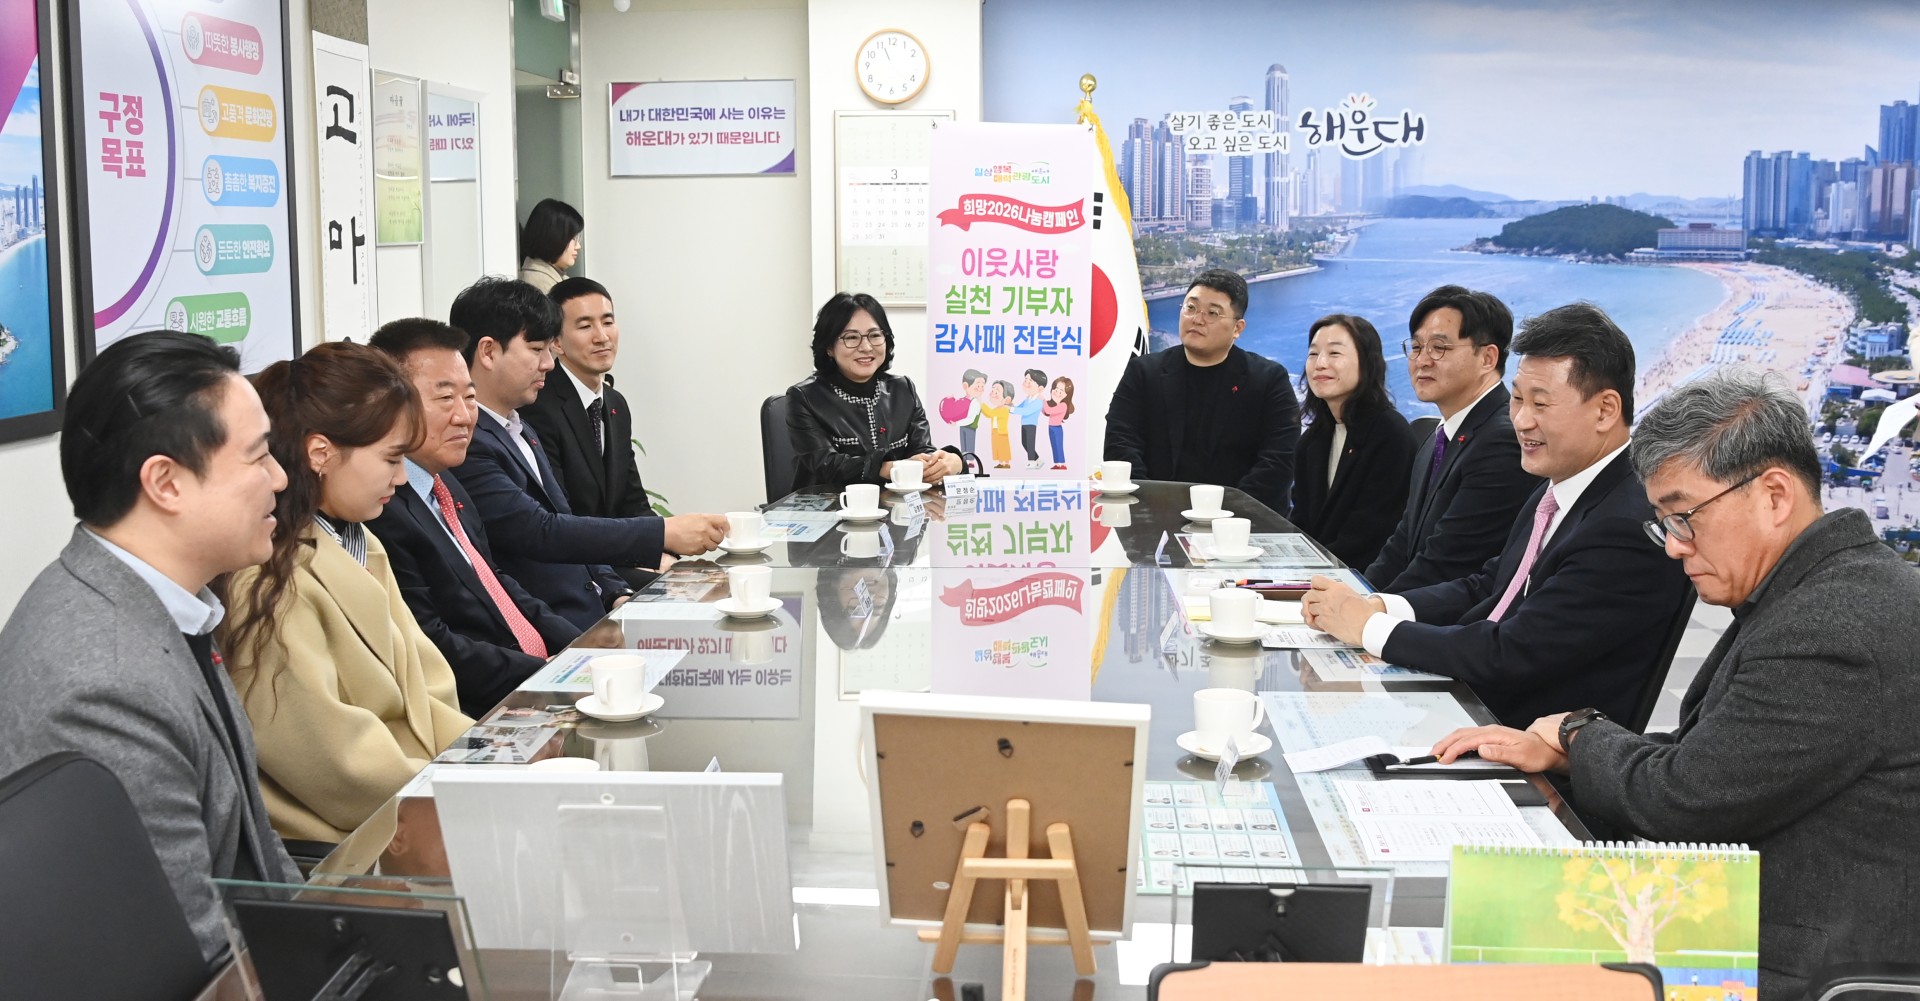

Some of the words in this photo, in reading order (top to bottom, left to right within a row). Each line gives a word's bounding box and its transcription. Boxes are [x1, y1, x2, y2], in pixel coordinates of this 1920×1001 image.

[204, 30, 229, 55] 따뜻한
[229, 34, 260, 62] 봉사행정
[876, 41, 884, 49] 11
[888, 37, 898, 46] 12
[867, 50, 876, 59] 10
[910, 48, 917, 57] 2
[864, 61, 871, 70] 9
[867, 74, 874, 83] 8
[909, 74, 915, 82] 4
[877, 83, 883, 92] 7
[889, 87, 895, 95] 6
[901, 83, 908, 92] 5
[98, 91, 145, 135] 구정
[221, 102, 244, 123] 고품격
[244, 103, 273, 128] 문화관광
[619, 108, 645, 122] 내가
[648, 107, 716, 122] 대한민국에
[719, 108, 744, 121] 사는
[748, 106, 786, 121] 이유는
[1171, 114, 1201, 131] 살기
[1207, 114, 1237, 131] 좋은
[1241, 114, 1271, 130] 도시
[625, 131, 685, 147] 해운대가
[688, 131, 714, 146] 있기
[717, 131, 780, 145] 때문입니다
[1299, 109, 1424, 156] 해운대
[1188, 137, 1217, 151] 오고
[1222, 136, 1253, 152] 싶은
[1257, 135, 1287, 151] 도시
[101, 137, 147, 178] 목표
[890, 168, 899, 180] 3
[974, 167, 993, 177] 일상
[1031, 175, 1050, 185] 도시
[224, 172, 248, 192] 촘촘한
[247, 172, 276, 194] 복지증진
[963, 198, 1080, 228] 희망2026나눔캠페인
[217, 242, 242, 260] 든든한
[242, 238, 270, 259] 안전확보
[961, 247, 1059, 279] 이웃사랑
[945, 284, 991, 315] 실천
[1002, 286, 1074, 317] 기부자
[190, 310, 216, 332] 시원한
[215, 307, 247, 330] 교통흐름
[935, 323, 1005, 354] 감사패
[1013, 325, 1082, 356] 전달식
